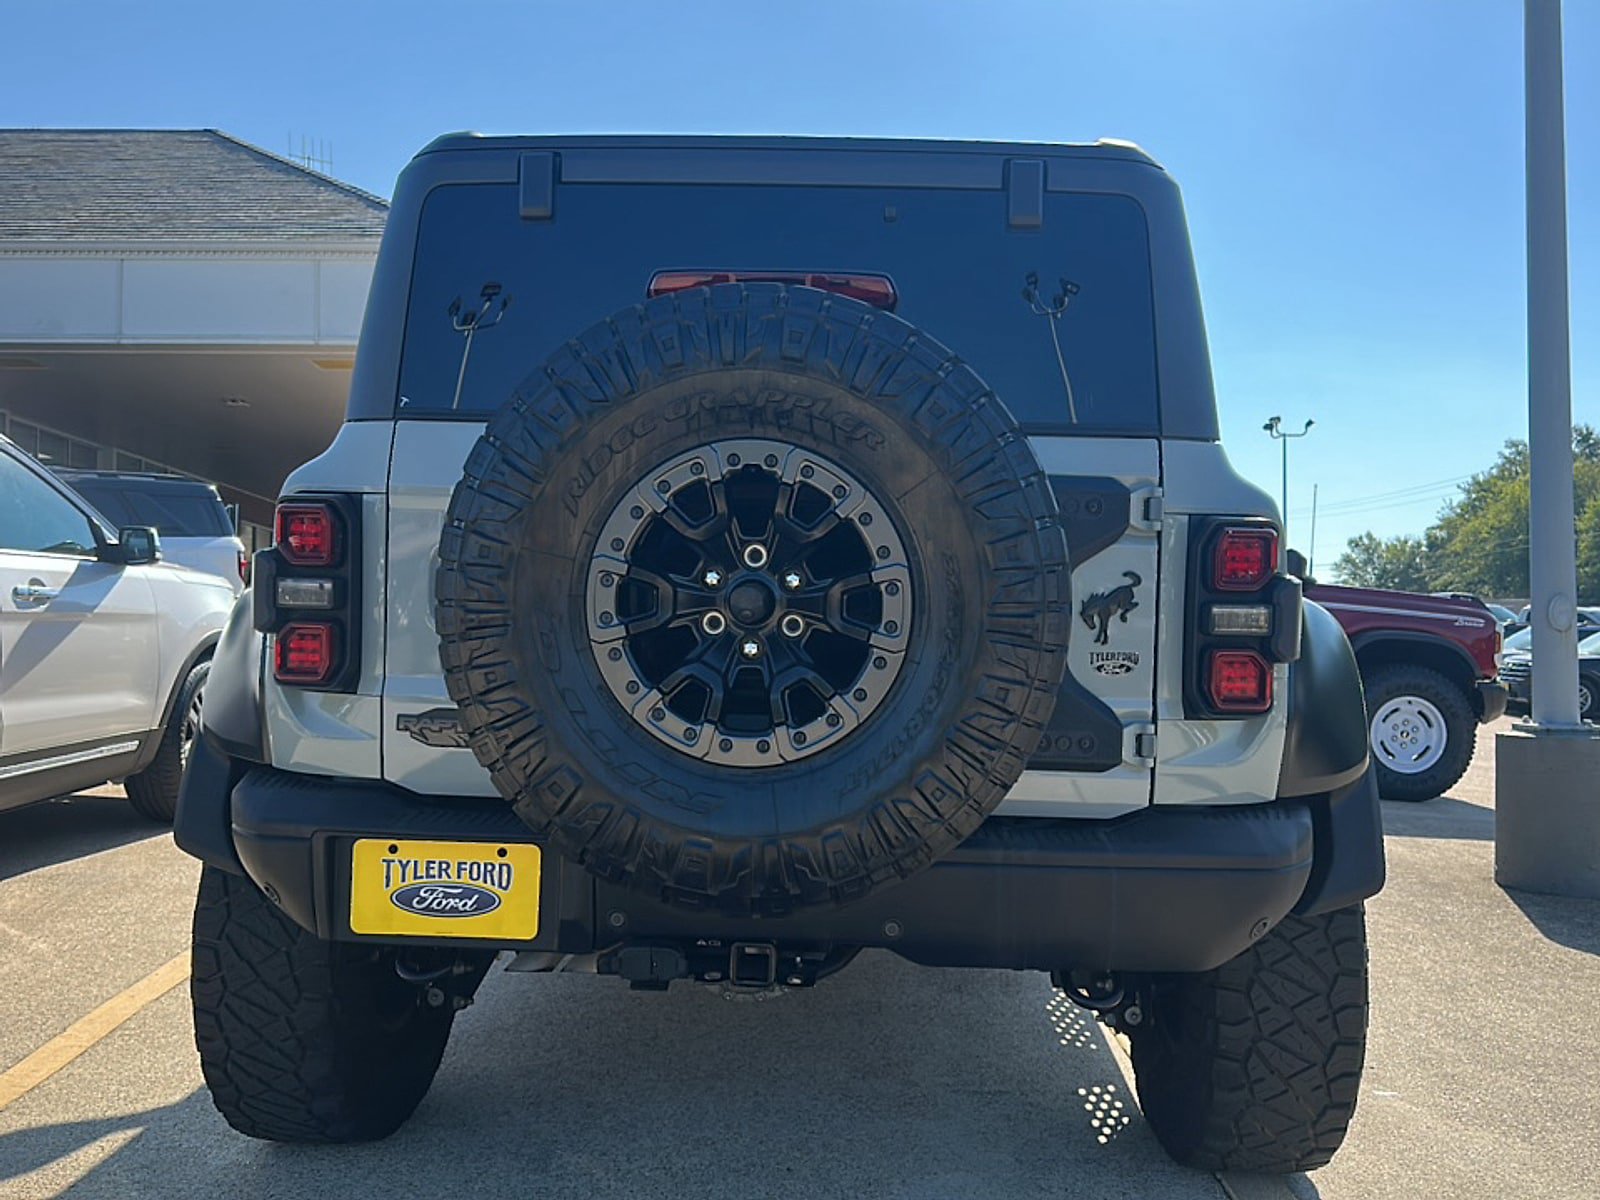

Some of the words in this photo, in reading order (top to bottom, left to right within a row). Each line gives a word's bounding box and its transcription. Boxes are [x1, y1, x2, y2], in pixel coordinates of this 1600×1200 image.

[565, 416, 658, 518] RIDGE
[664, 387, 885, 451] GRAPPLER
[1088, 651, 1116, 666] TYLER
[1117, 651, 1140, 666] FORD
[382, 858, 453, 889] TYLER
[457, 860, 513, 891] FORD
[412, 886, 479, 911] Ford
